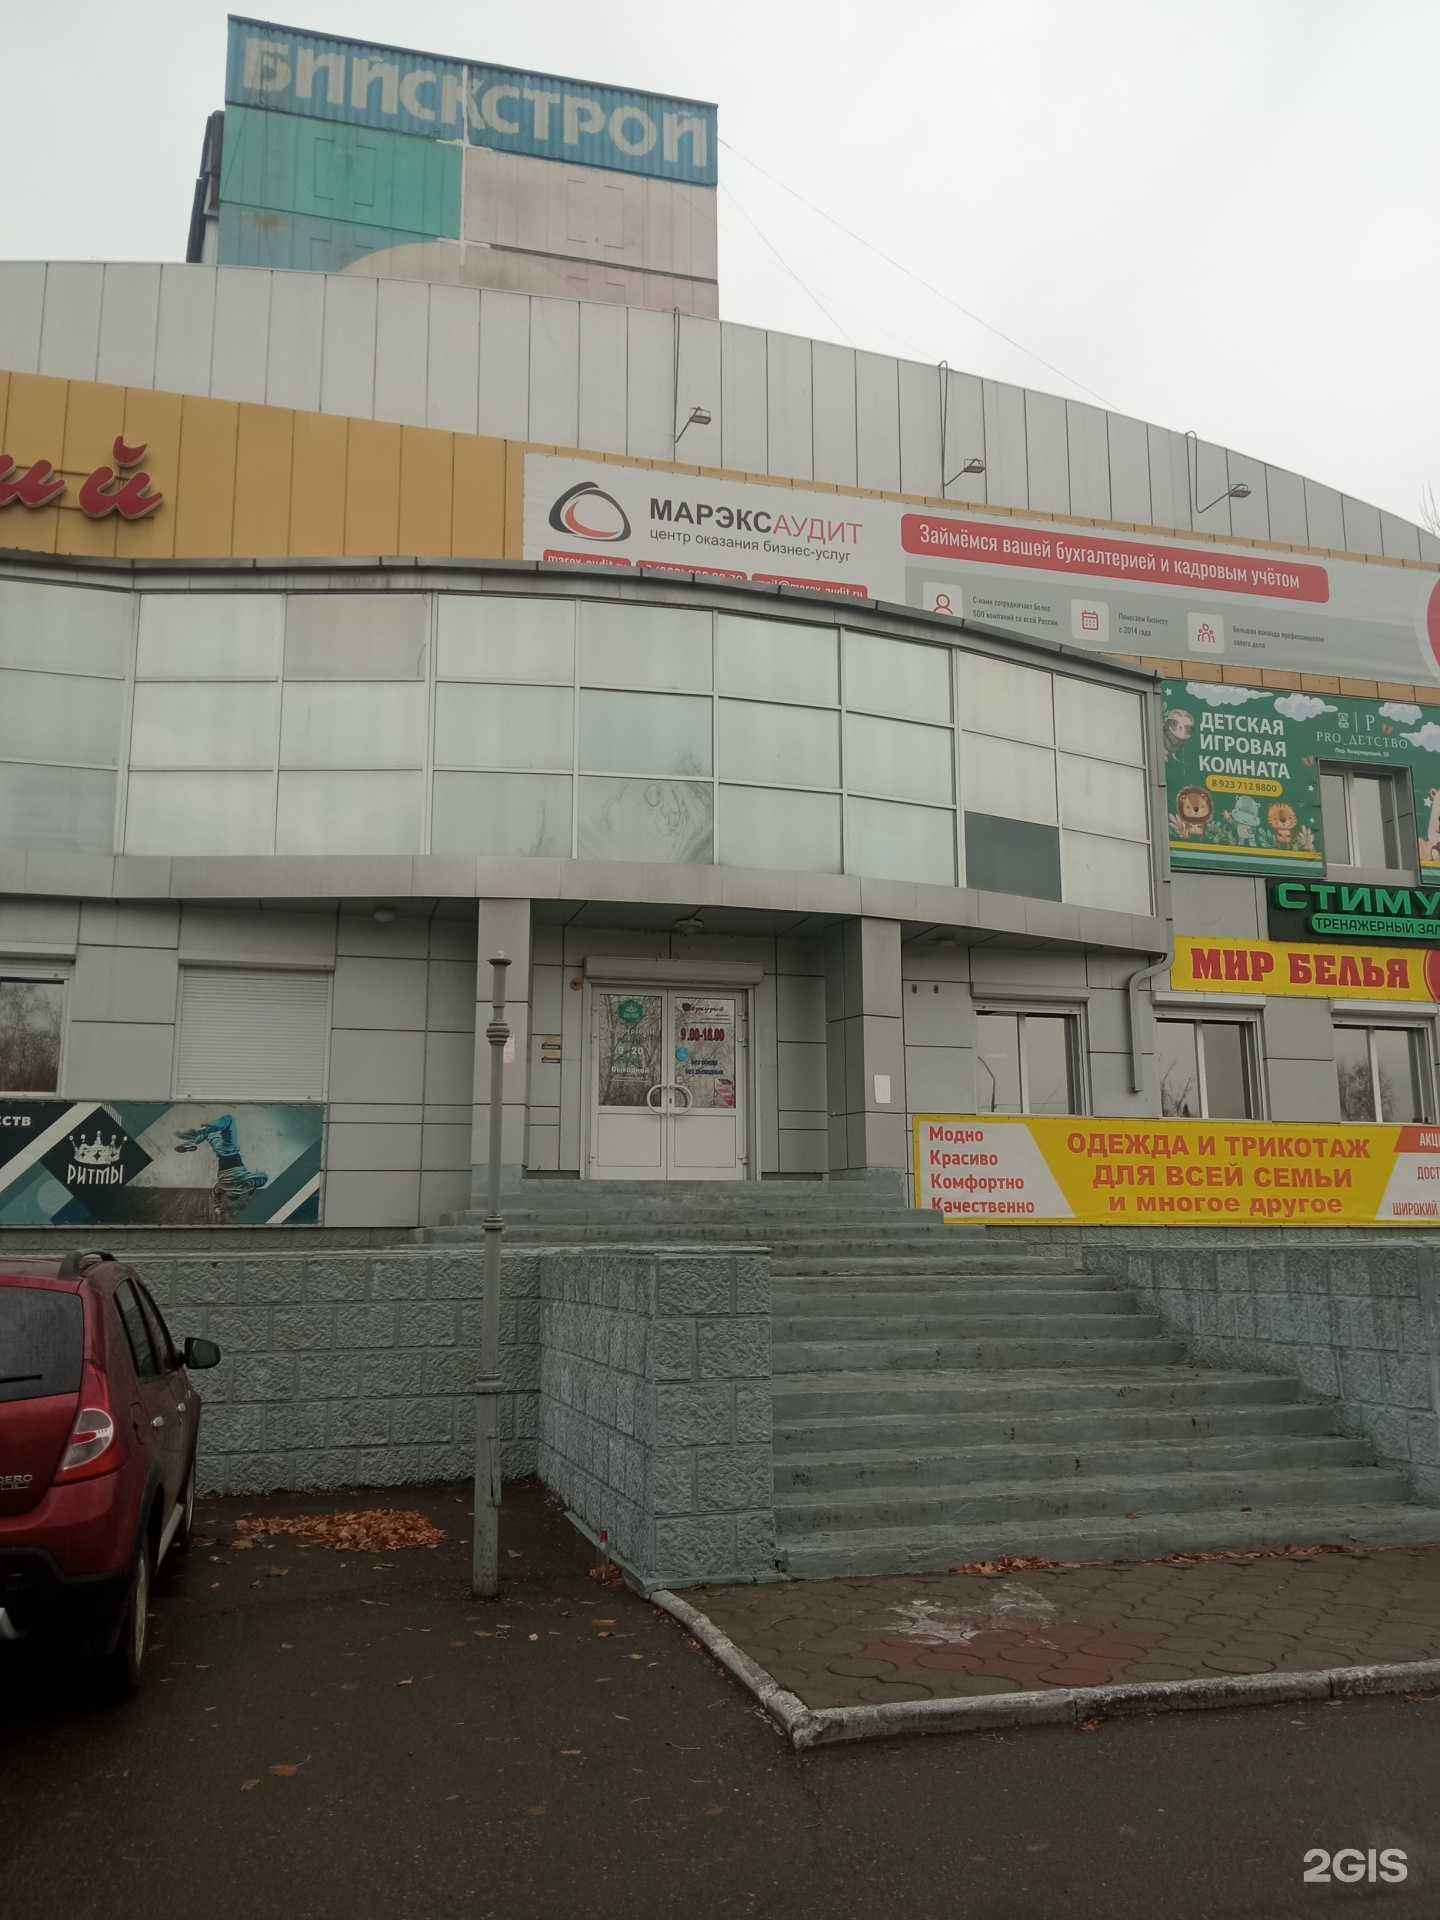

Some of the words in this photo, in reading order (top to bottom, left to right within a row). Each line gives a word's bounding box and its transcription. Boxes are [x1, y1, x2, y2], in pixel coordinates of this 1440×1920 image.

[650, 498, 863, 544] МАРЭКСАУДИТ
[650, 527, 691, 543] центр
[695, 533, 759, 551] оказания
[763, 539, 850, 562] бизнес-услуг
[919, 523, 998, 551] Займёмся
[1003, 536, 1051, 559] вашей
[1056, 541, 1155, 571] бухгалтерией
[1160, 559, 1169, 571] и
[1174, 560, 1247, 582] кадровым
[1251, 567, 1300, 589] учётом
[1200, 712, 1284, 736] ДЕТСКАЯ
[1200, 734, 1286, 757] ИГРОВАЯ
[1199, 755, 1291, 779] КОМНАТА
[1315, 917, 1414, 934] ТРЕНАЖЕРНЫЙ
[1191, 948, 1274, 982] МИР
[1288, 953, 1409, 988] БЕЛЬЯ
[0, 1115, 31, 1126] СТВ
[929, 1126, 984, 1144] Модно
[1067, 1132, 1189, 1158] ОДЕЖДА
[1198, 1135, 1216, 1155] И
[1224, 1136, 1370, 1158] ТРИКОТАЖ
[930, 1150, 998, 1168] Красиво
[67, 1163, 124, 1185] РИТМЫ
[931, 1174, 1024, 1193] Комфортно
[1093, 1165, 1155, 1188] ДЛЯ
[1166, 1162, 1243, 1187] ВСЕЙ
[1254, 1167, 1352, 1188] СЕМЬИ
[932, 1197, 1034, 1213] Качественно
[1136, 1197, 1240, 1212] многое
[1249, 1198, 1343, 1217] другое
[1392, 1200, 1438, 1216] ШИРОКИЙ
